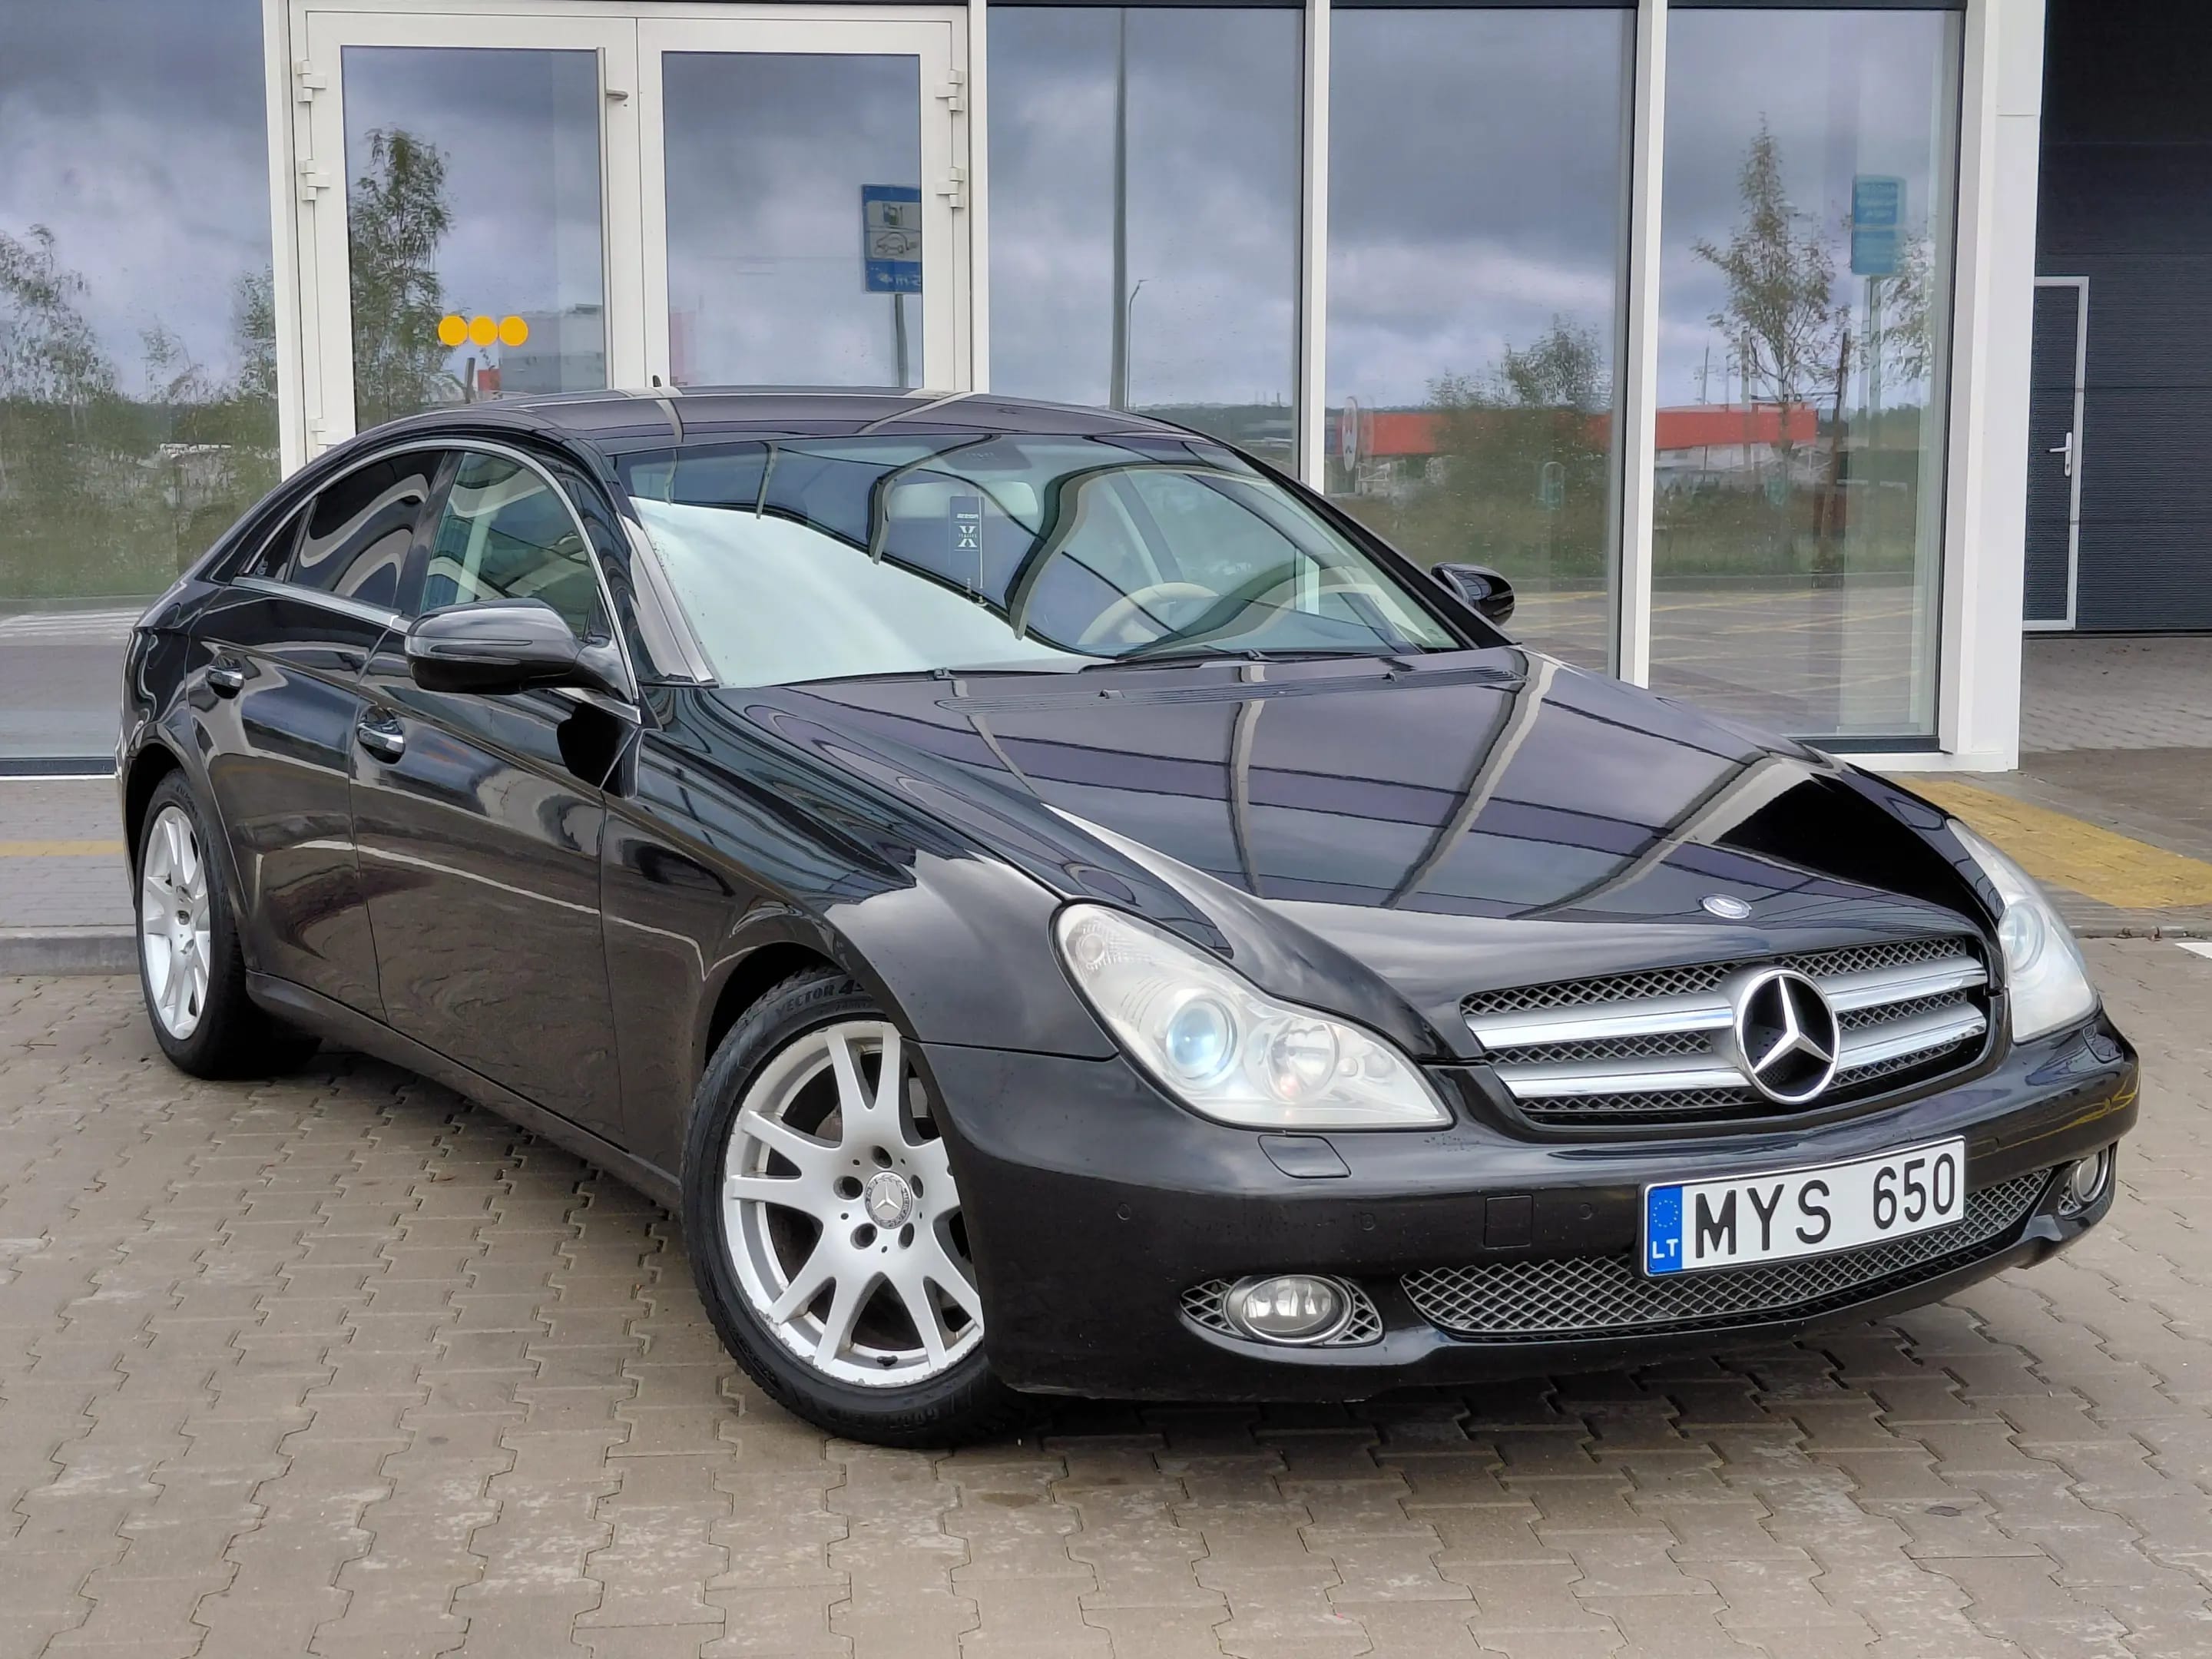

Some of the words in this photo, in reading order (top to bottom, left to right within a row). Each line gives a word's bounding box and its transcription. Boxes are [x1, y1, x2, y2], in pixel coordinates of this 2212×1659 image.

[775, 984, 836, 1018] VECTOR
[1695, 1180, 1831, 1259] MYS
[1873, 1153, 1955, 1230] 650
[1652, 1238, 1679, 1259] LT
